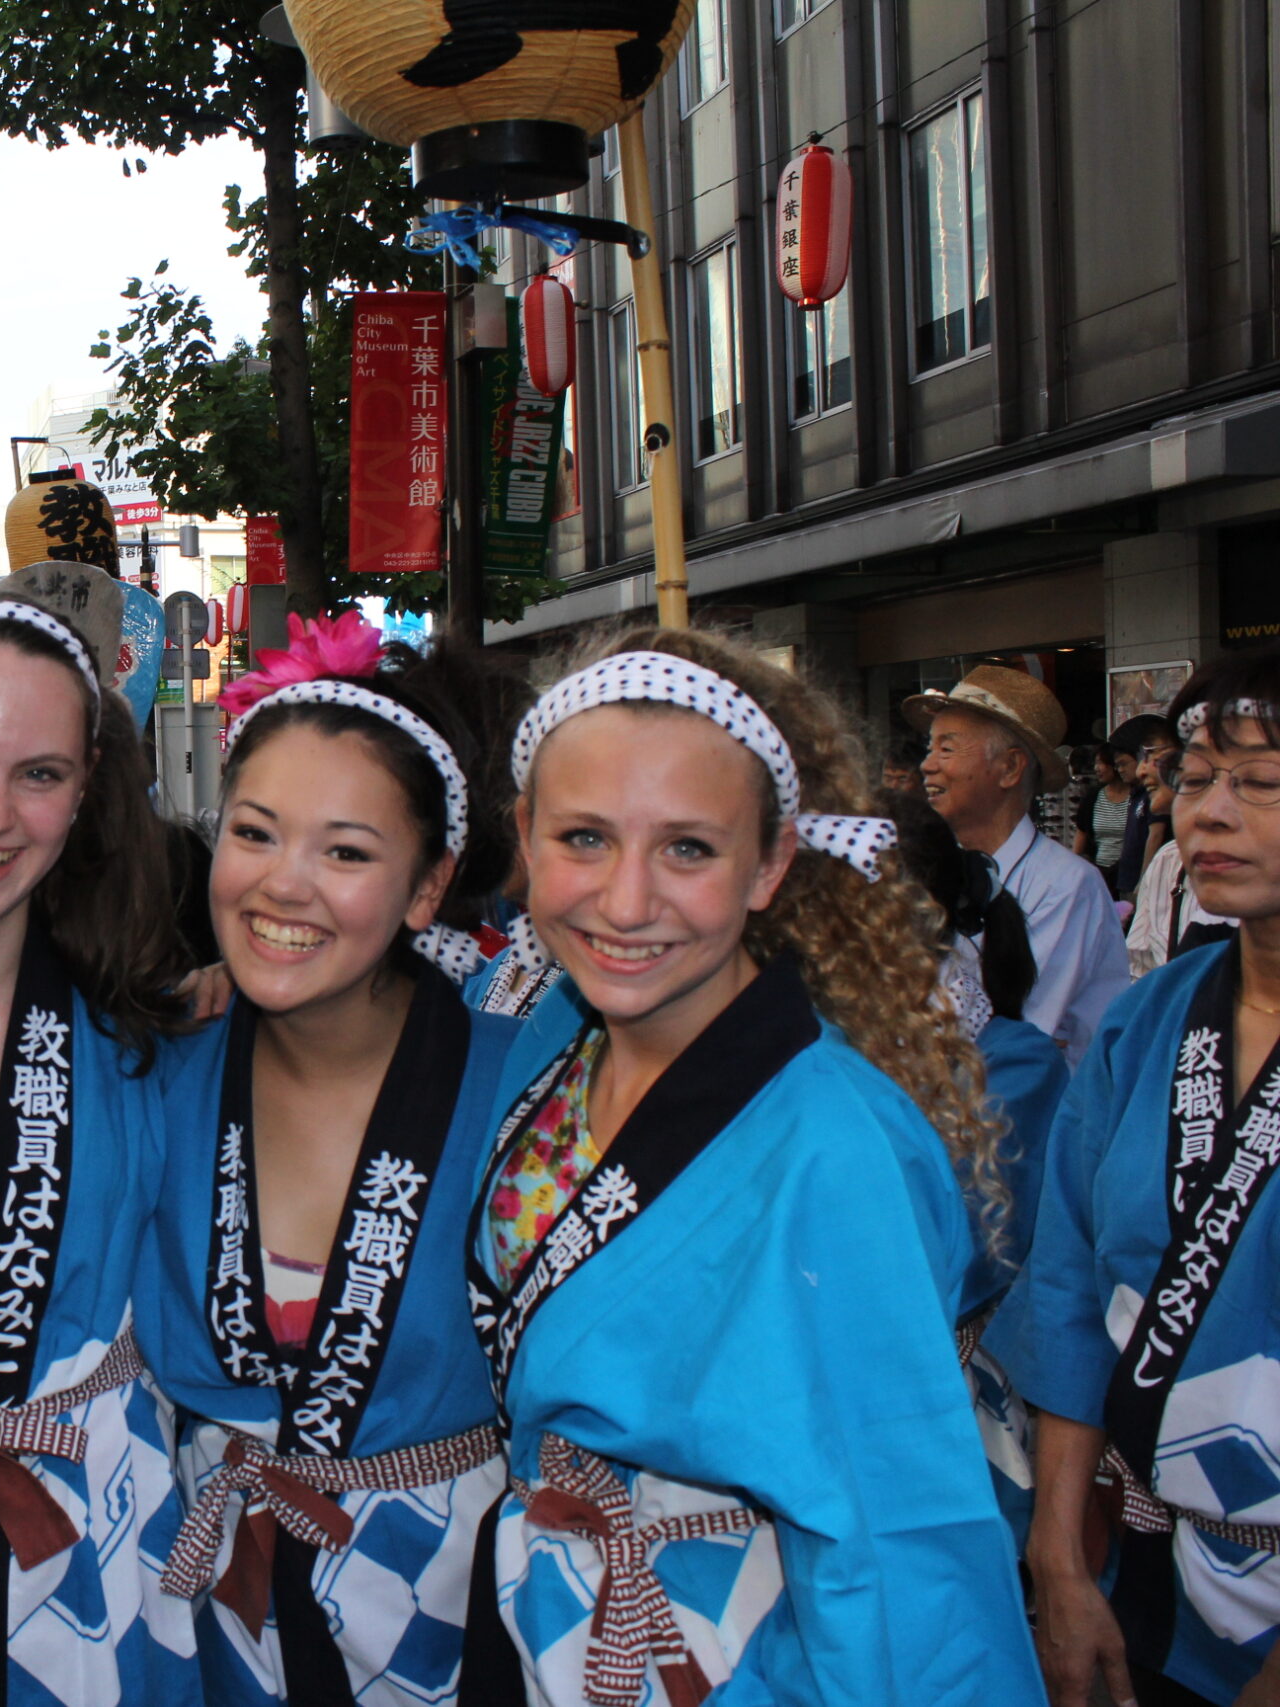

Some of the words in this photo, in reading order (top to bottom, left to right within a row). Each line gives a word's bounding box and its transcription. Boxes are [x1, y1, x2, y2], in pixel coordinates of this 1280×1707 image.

[782, 170, 800, 278] 千葉銀座
[358, 314, 394, 325] Chiba
[357, 327, 381, 340] City
[356, 340, 409, 352] Museum
[356, 353, 369, 364] of
[355, 366, 376, 378] Art
[408, 315, 439, 507] 千葉市美術館
[511, 415, 553, 465] JAZZ
[506, 468, 548, 524] CHIBA
[127, 507, 159, 520] 徒歩3分
